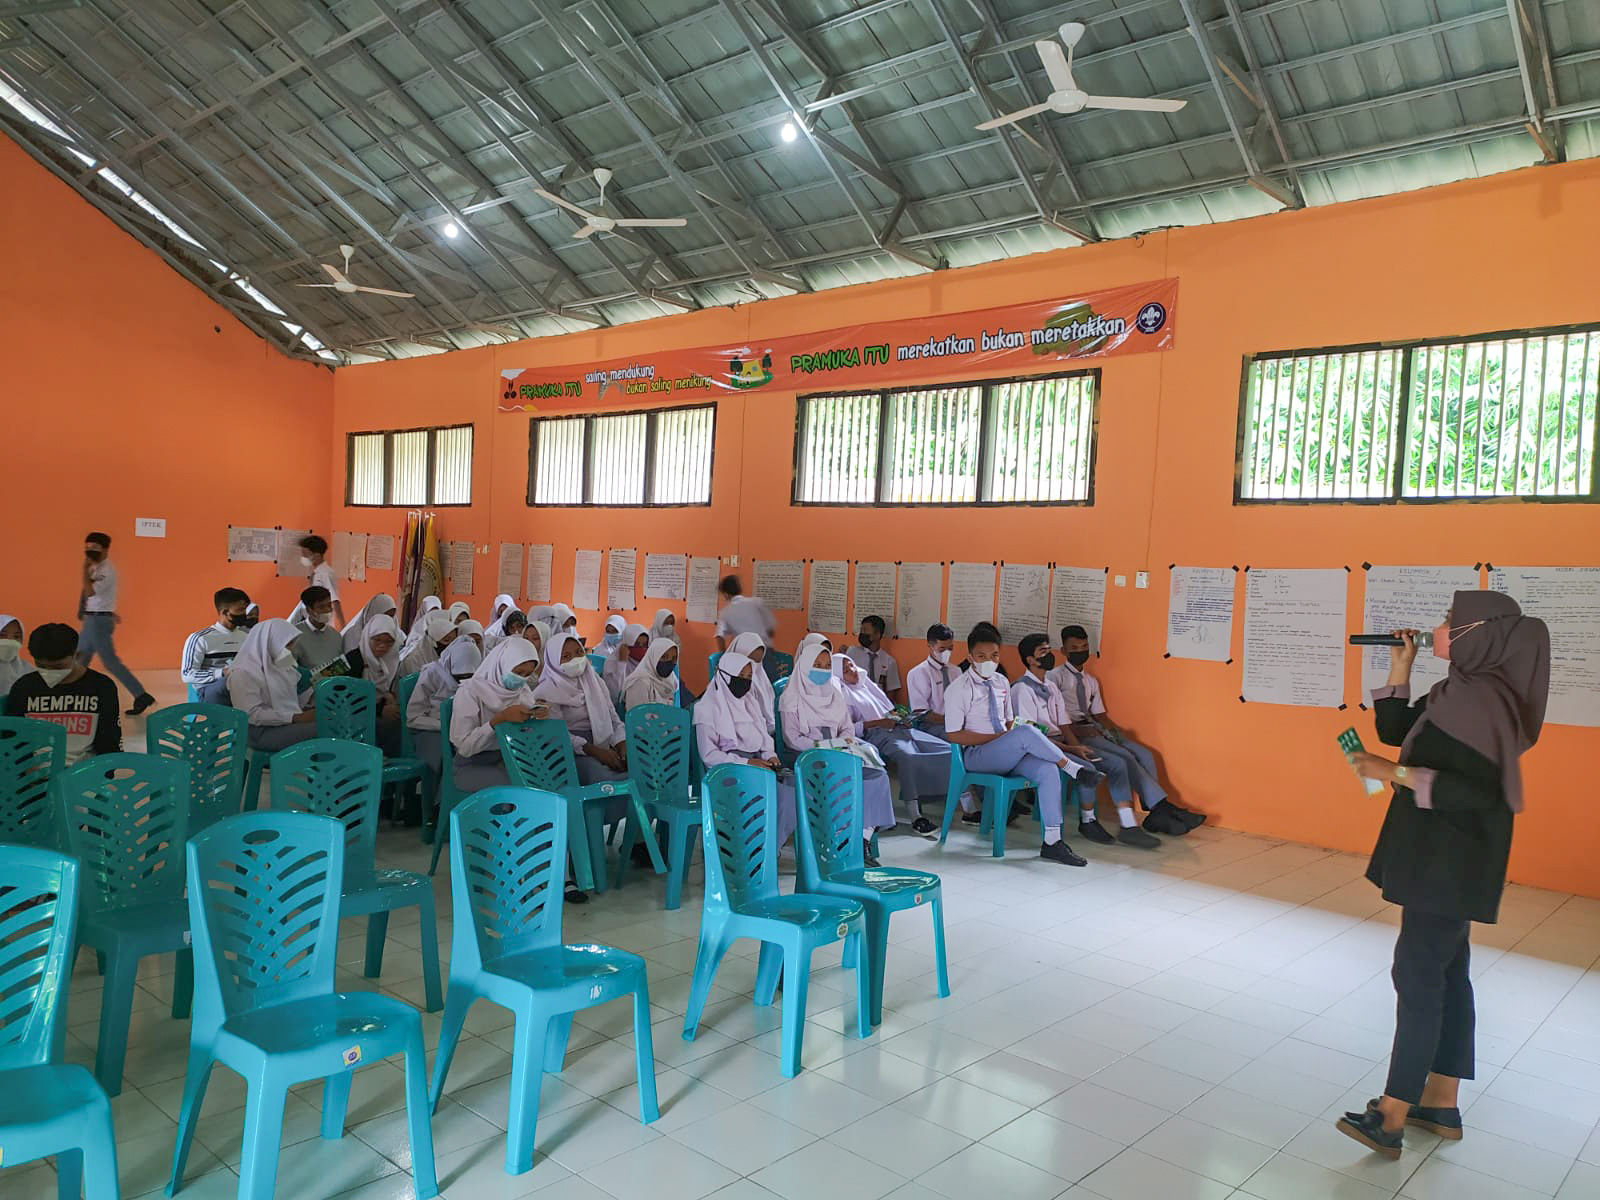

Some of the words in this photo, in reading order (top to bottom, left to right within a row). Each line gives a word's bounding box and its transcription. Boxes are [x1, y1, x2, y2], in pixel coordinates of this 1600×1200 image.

[790, 347, 861, 374] PRAMUKA
[863, 343, 890, 366] ITU
[896, 334, 976, 361] merekatkan
[980, 327, 1025, 351] bukan
[1030, 314, 1126, 346] meretakkan
[585, 369, 607, 385] saling
[609, 363, 656, 381] mendukung
[625, 380, 648, 394] bukan
[650, 378, 672, 394] saling
[674, 373, 712, 390] menikung
[27, 695, 100, 712] MEMPHIS
